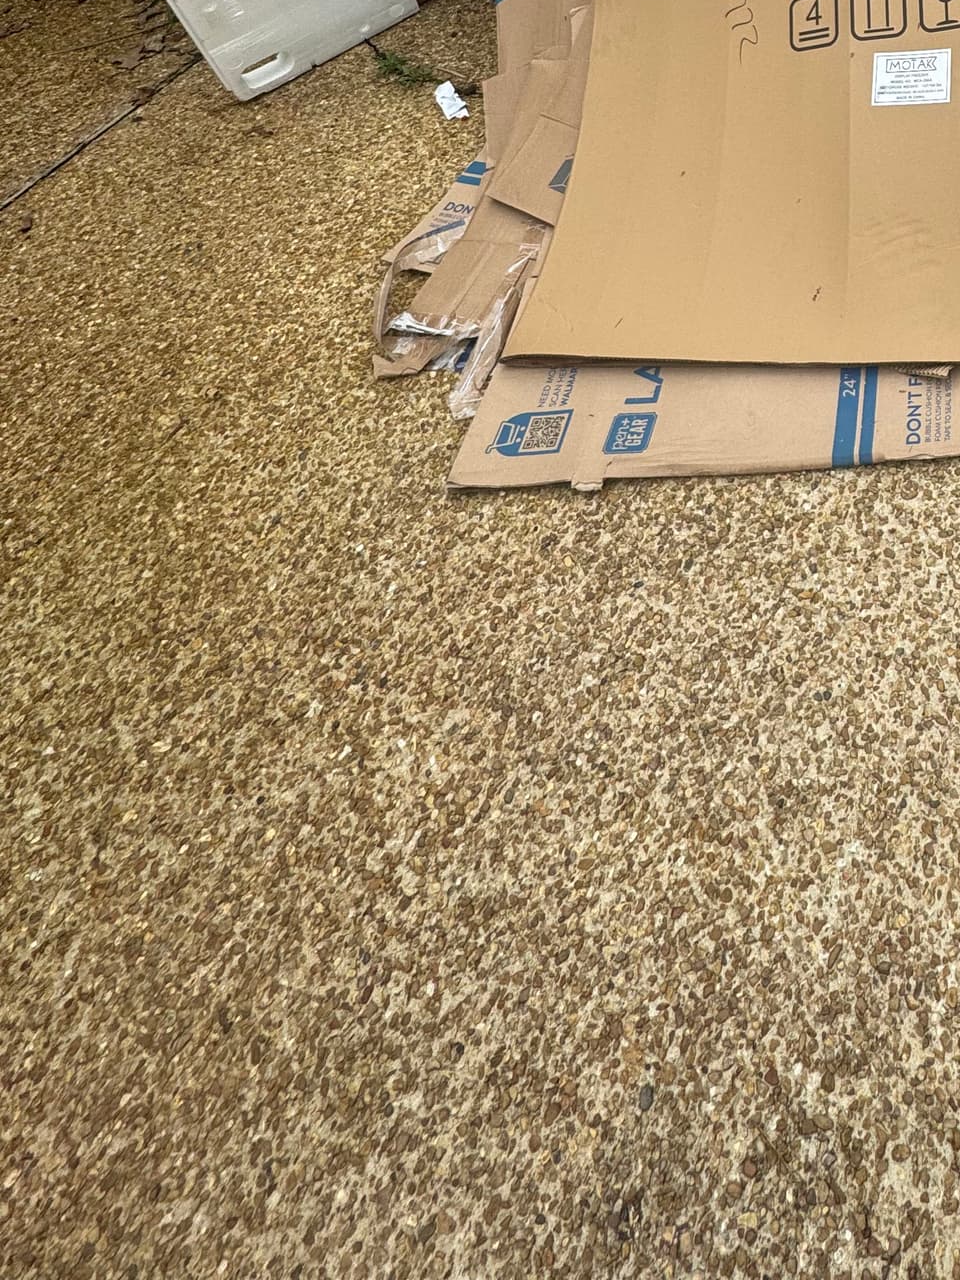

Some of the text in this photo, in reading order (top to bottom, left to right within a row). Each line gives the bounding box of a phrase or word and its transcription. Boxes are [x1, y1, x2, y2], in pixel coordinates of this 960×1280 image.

[805, 0, 822, 26] 4
[889, 59, 934, 71] MOTAK
[443, 201, 475, 215] DON
[537, 384, 551, 407] NEED
[624, 366, 664, 404] LA
[842, 373, 857, 397] 24"
[925, 387, 933, 417] CUSHION
[934, 391, 942, 421] CUSHION
[944, 399, 952, 414] SEAL
[906, 391, 923, 445] DON'T
[944, 415, 952, 424] TO
[625, 418, 648, 447] GEAR
[924, 418, 933, 443] BUBBLE
[934, 422, 942, 442] FOAM
[943, 426, 952, 442] TAPE
